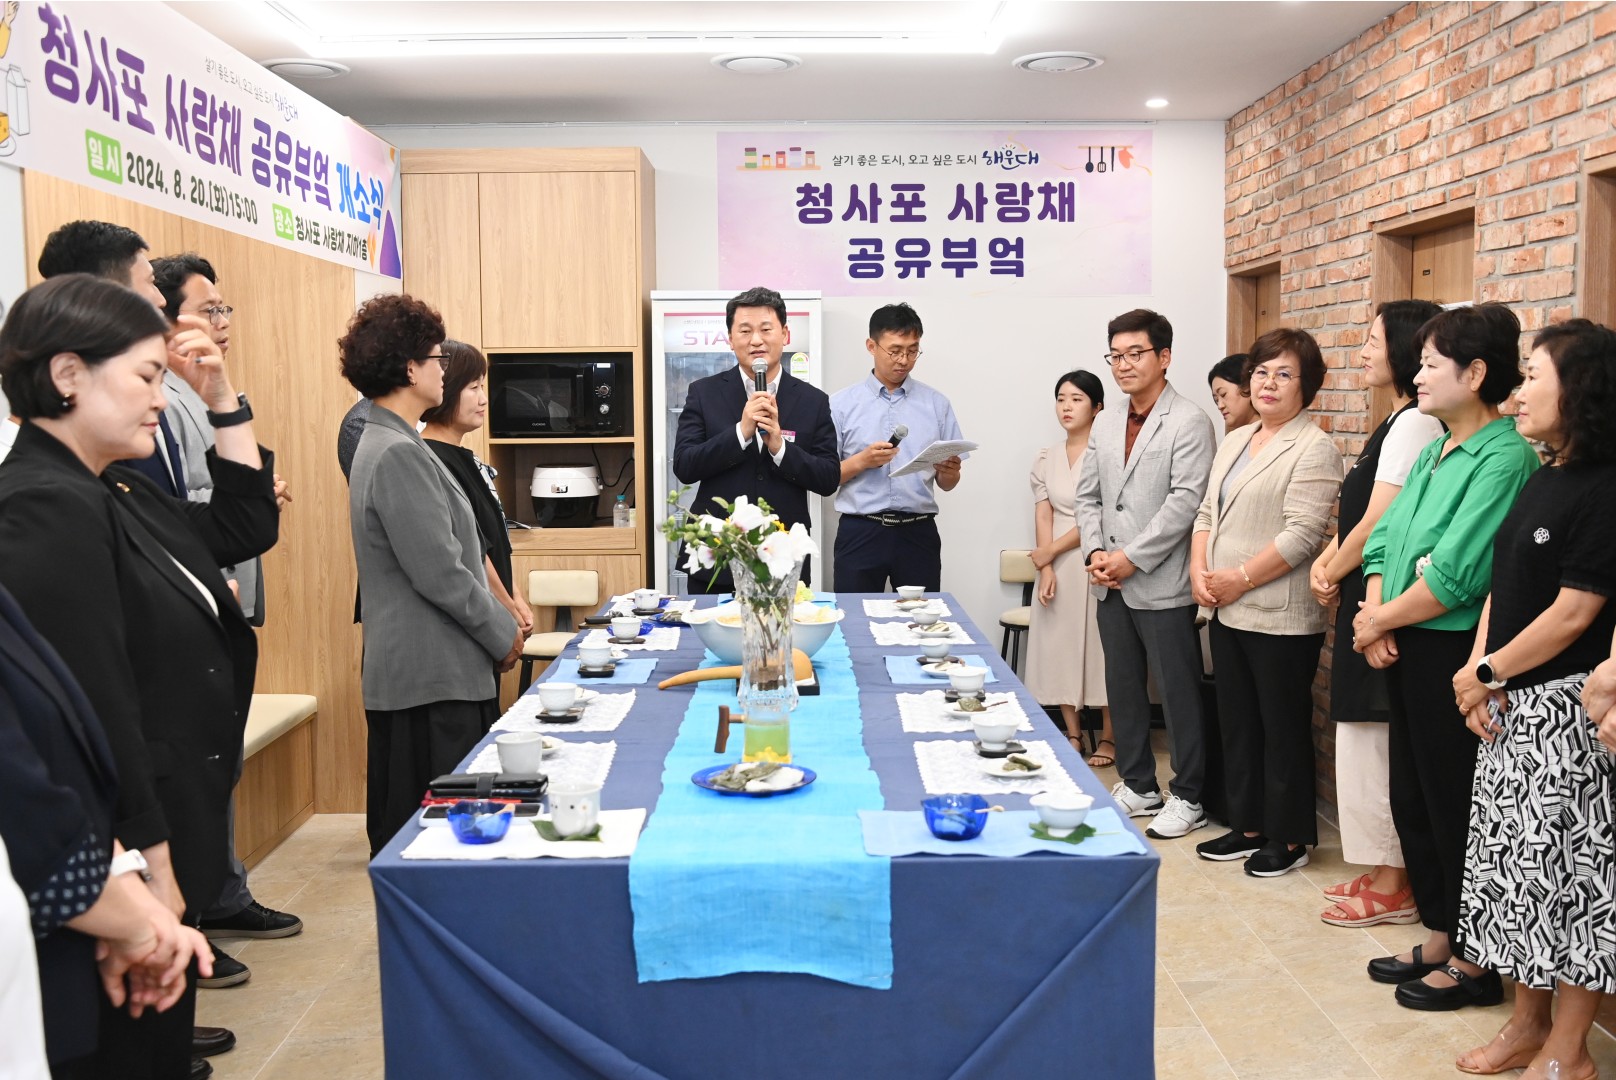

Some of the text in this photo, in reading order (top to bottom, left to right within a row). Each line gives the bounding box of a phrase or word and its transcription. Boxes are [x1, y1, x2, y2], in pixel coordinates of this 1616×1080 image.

[37, 1, 384, 231] 청사포 사랑채 공유부엌 개소식
[88, 137, 120, 177] 일시
[126, 151, 168, 195] 2024.
[174, 169, 186, 200] 8.
[832, 149, 1039, 170] 살기 좋은 도시, 오고 싶은 도시 해운대
[274, 208, 293, 235] 장소
[795, 181, 1075, 225] 청사포 사랑채
[295, 214, 367, 261] 청사포 사랑채 지하1층
[847, 236, 1025, 280] 공유부엌
